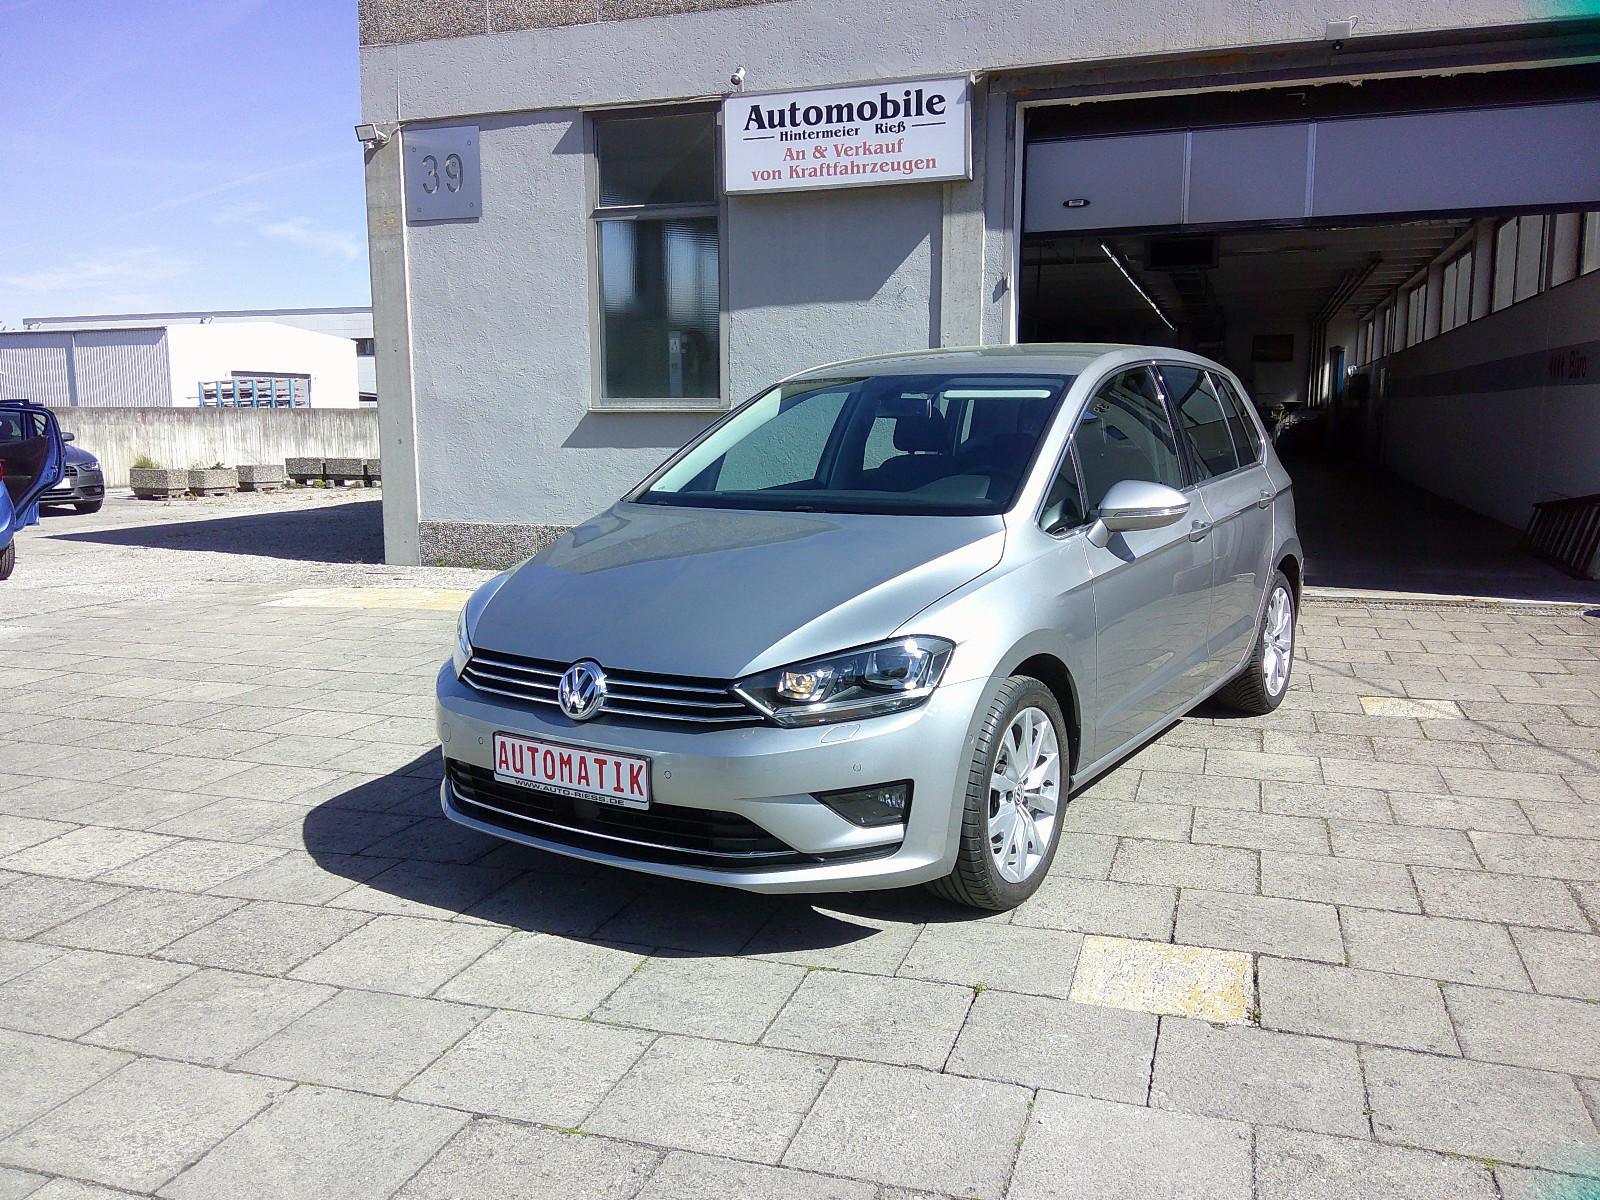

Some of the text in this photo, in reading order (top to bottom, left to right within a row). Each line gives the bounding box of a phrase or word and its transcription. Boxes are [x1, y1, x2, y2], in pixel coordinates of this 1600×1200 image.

[743, 88, 946, 131] Automobile
[779, 121, 906, 142] Hintermeier Rieß
[783, 138, 905, 162] An & Verkauf
[422, 153, 464, 194] 39
[751, 157, 937, 182] von Kraftfahrzeugen
[499, 740, 644, 796] AUTOMATIK
